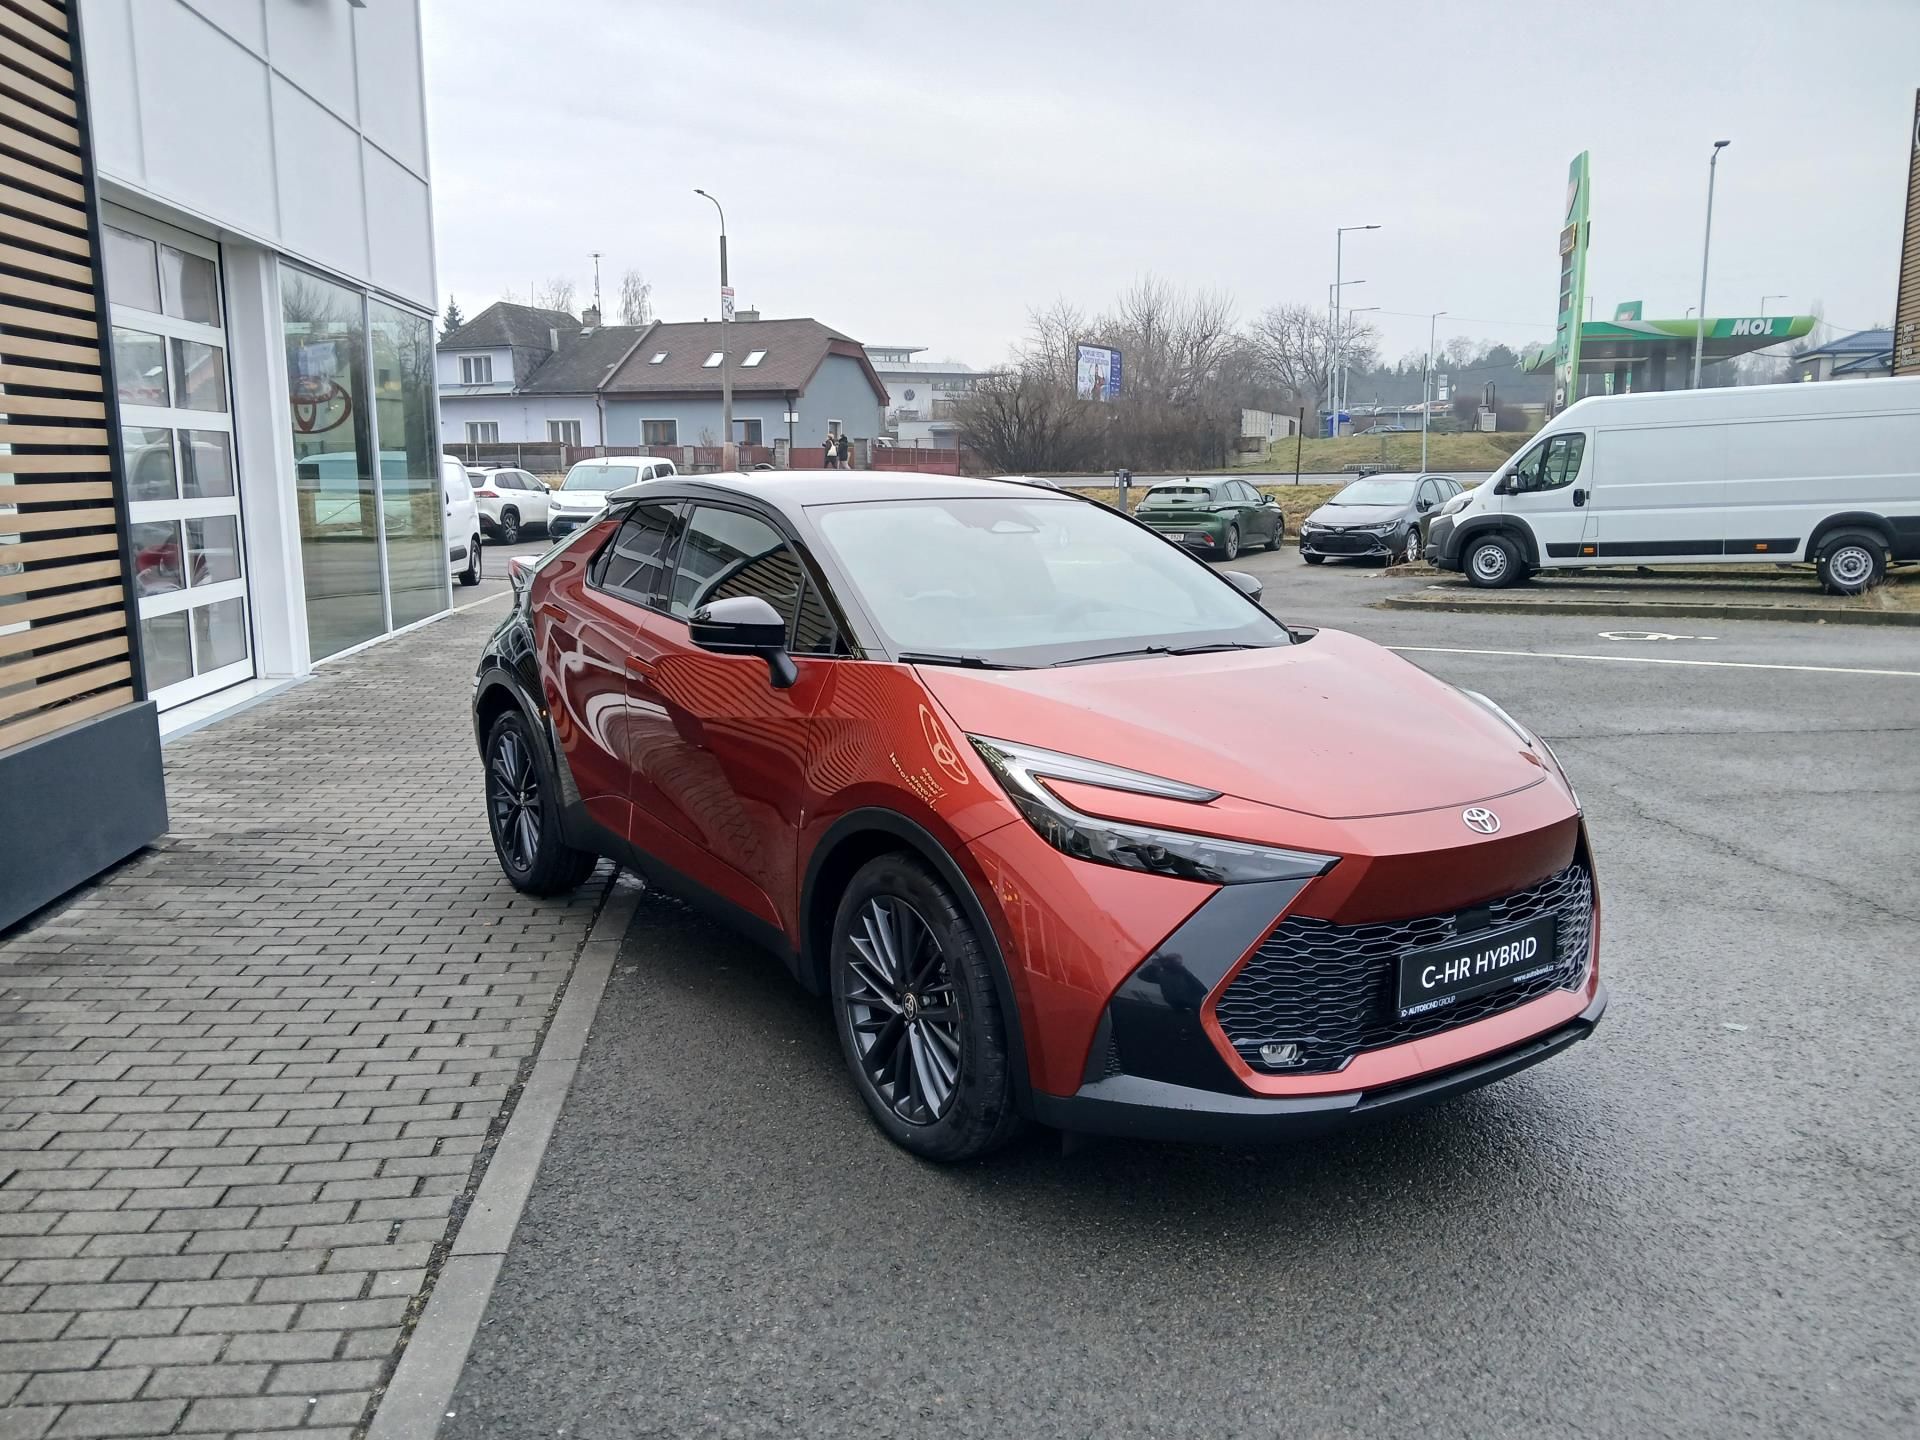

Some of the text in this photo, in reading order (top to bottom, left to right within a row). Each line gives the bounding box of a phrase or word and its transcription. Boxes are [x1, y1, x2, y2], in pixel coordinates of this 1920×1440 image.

[1730, 318, 1774, 336] MOL
[1421, 937, 1537, 989] C-HR HYBRID
[1513, 965, 1554, 983] www.autobond.cz
[1408, 995, 1456, 1016] AUTOBOND GROUP
